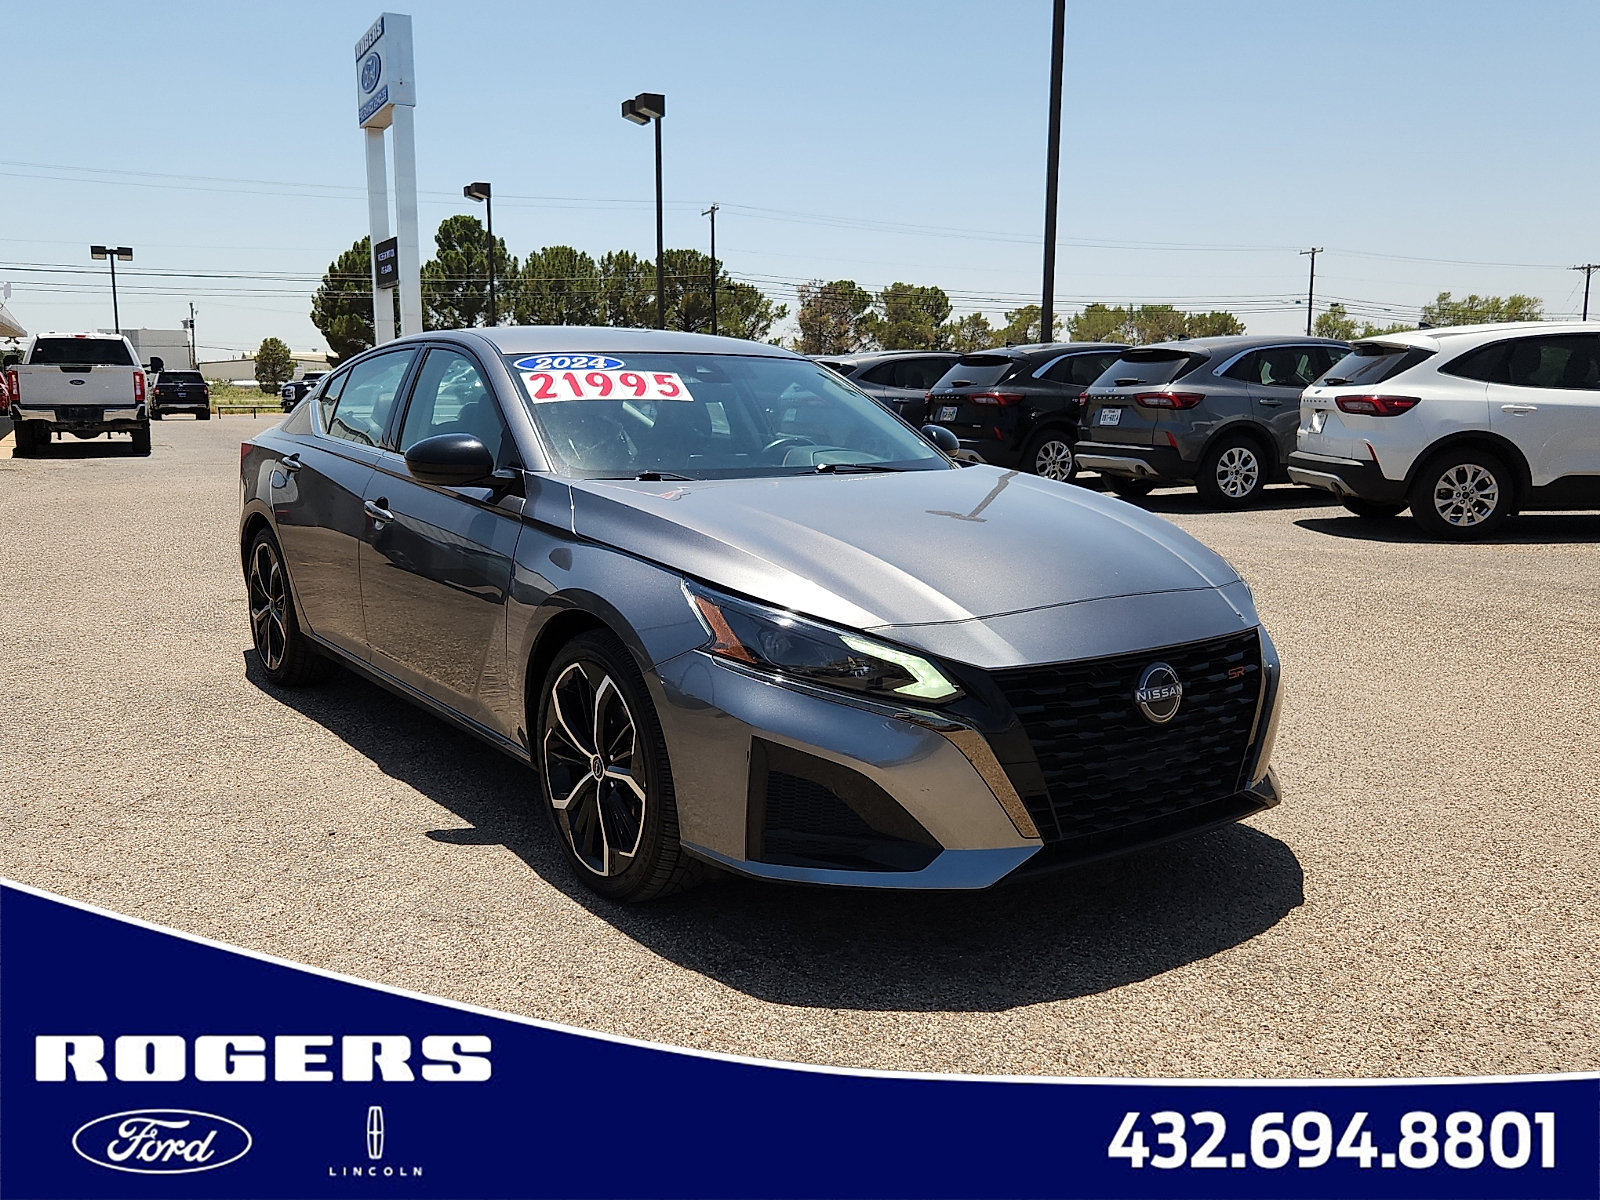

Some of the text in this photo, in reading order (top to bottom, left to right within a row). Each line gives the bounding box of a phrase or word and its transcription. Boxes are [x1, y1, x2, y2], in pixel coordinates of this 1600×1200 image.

[534, 356, 607, 369] 2024
[529, 372, 680, 399] 21995
[1228, 666, 1245, 680] SR
[1136, 685, 1183, 701] NISSAN
